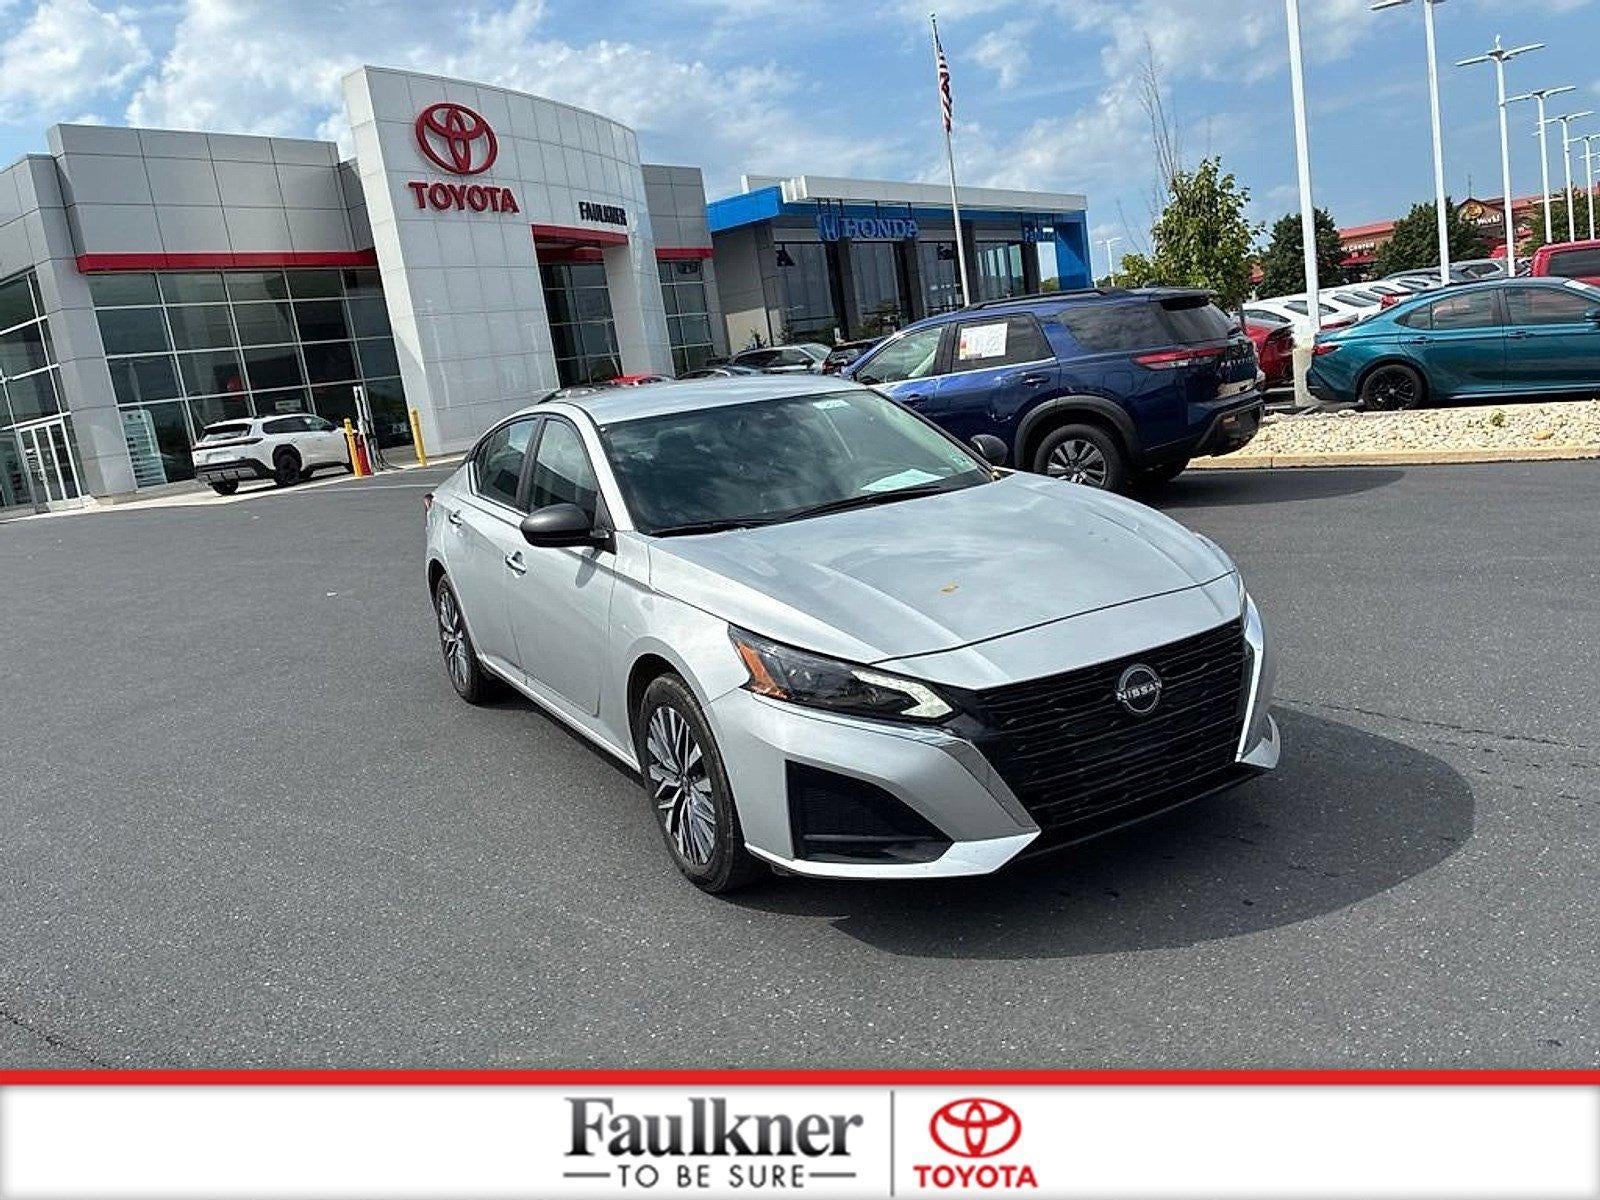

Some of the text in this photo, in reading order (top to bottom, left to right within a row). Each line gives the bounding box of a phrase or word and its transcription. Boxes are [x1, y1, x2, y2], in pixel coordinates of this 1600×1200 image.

[408, 181, 520, 214] TOYOTA
[578, 201, 627, 226] FAULKNER
[841, 218, 919, 240] HONDA
[1117, 681, 1163, 701] NISSAN
